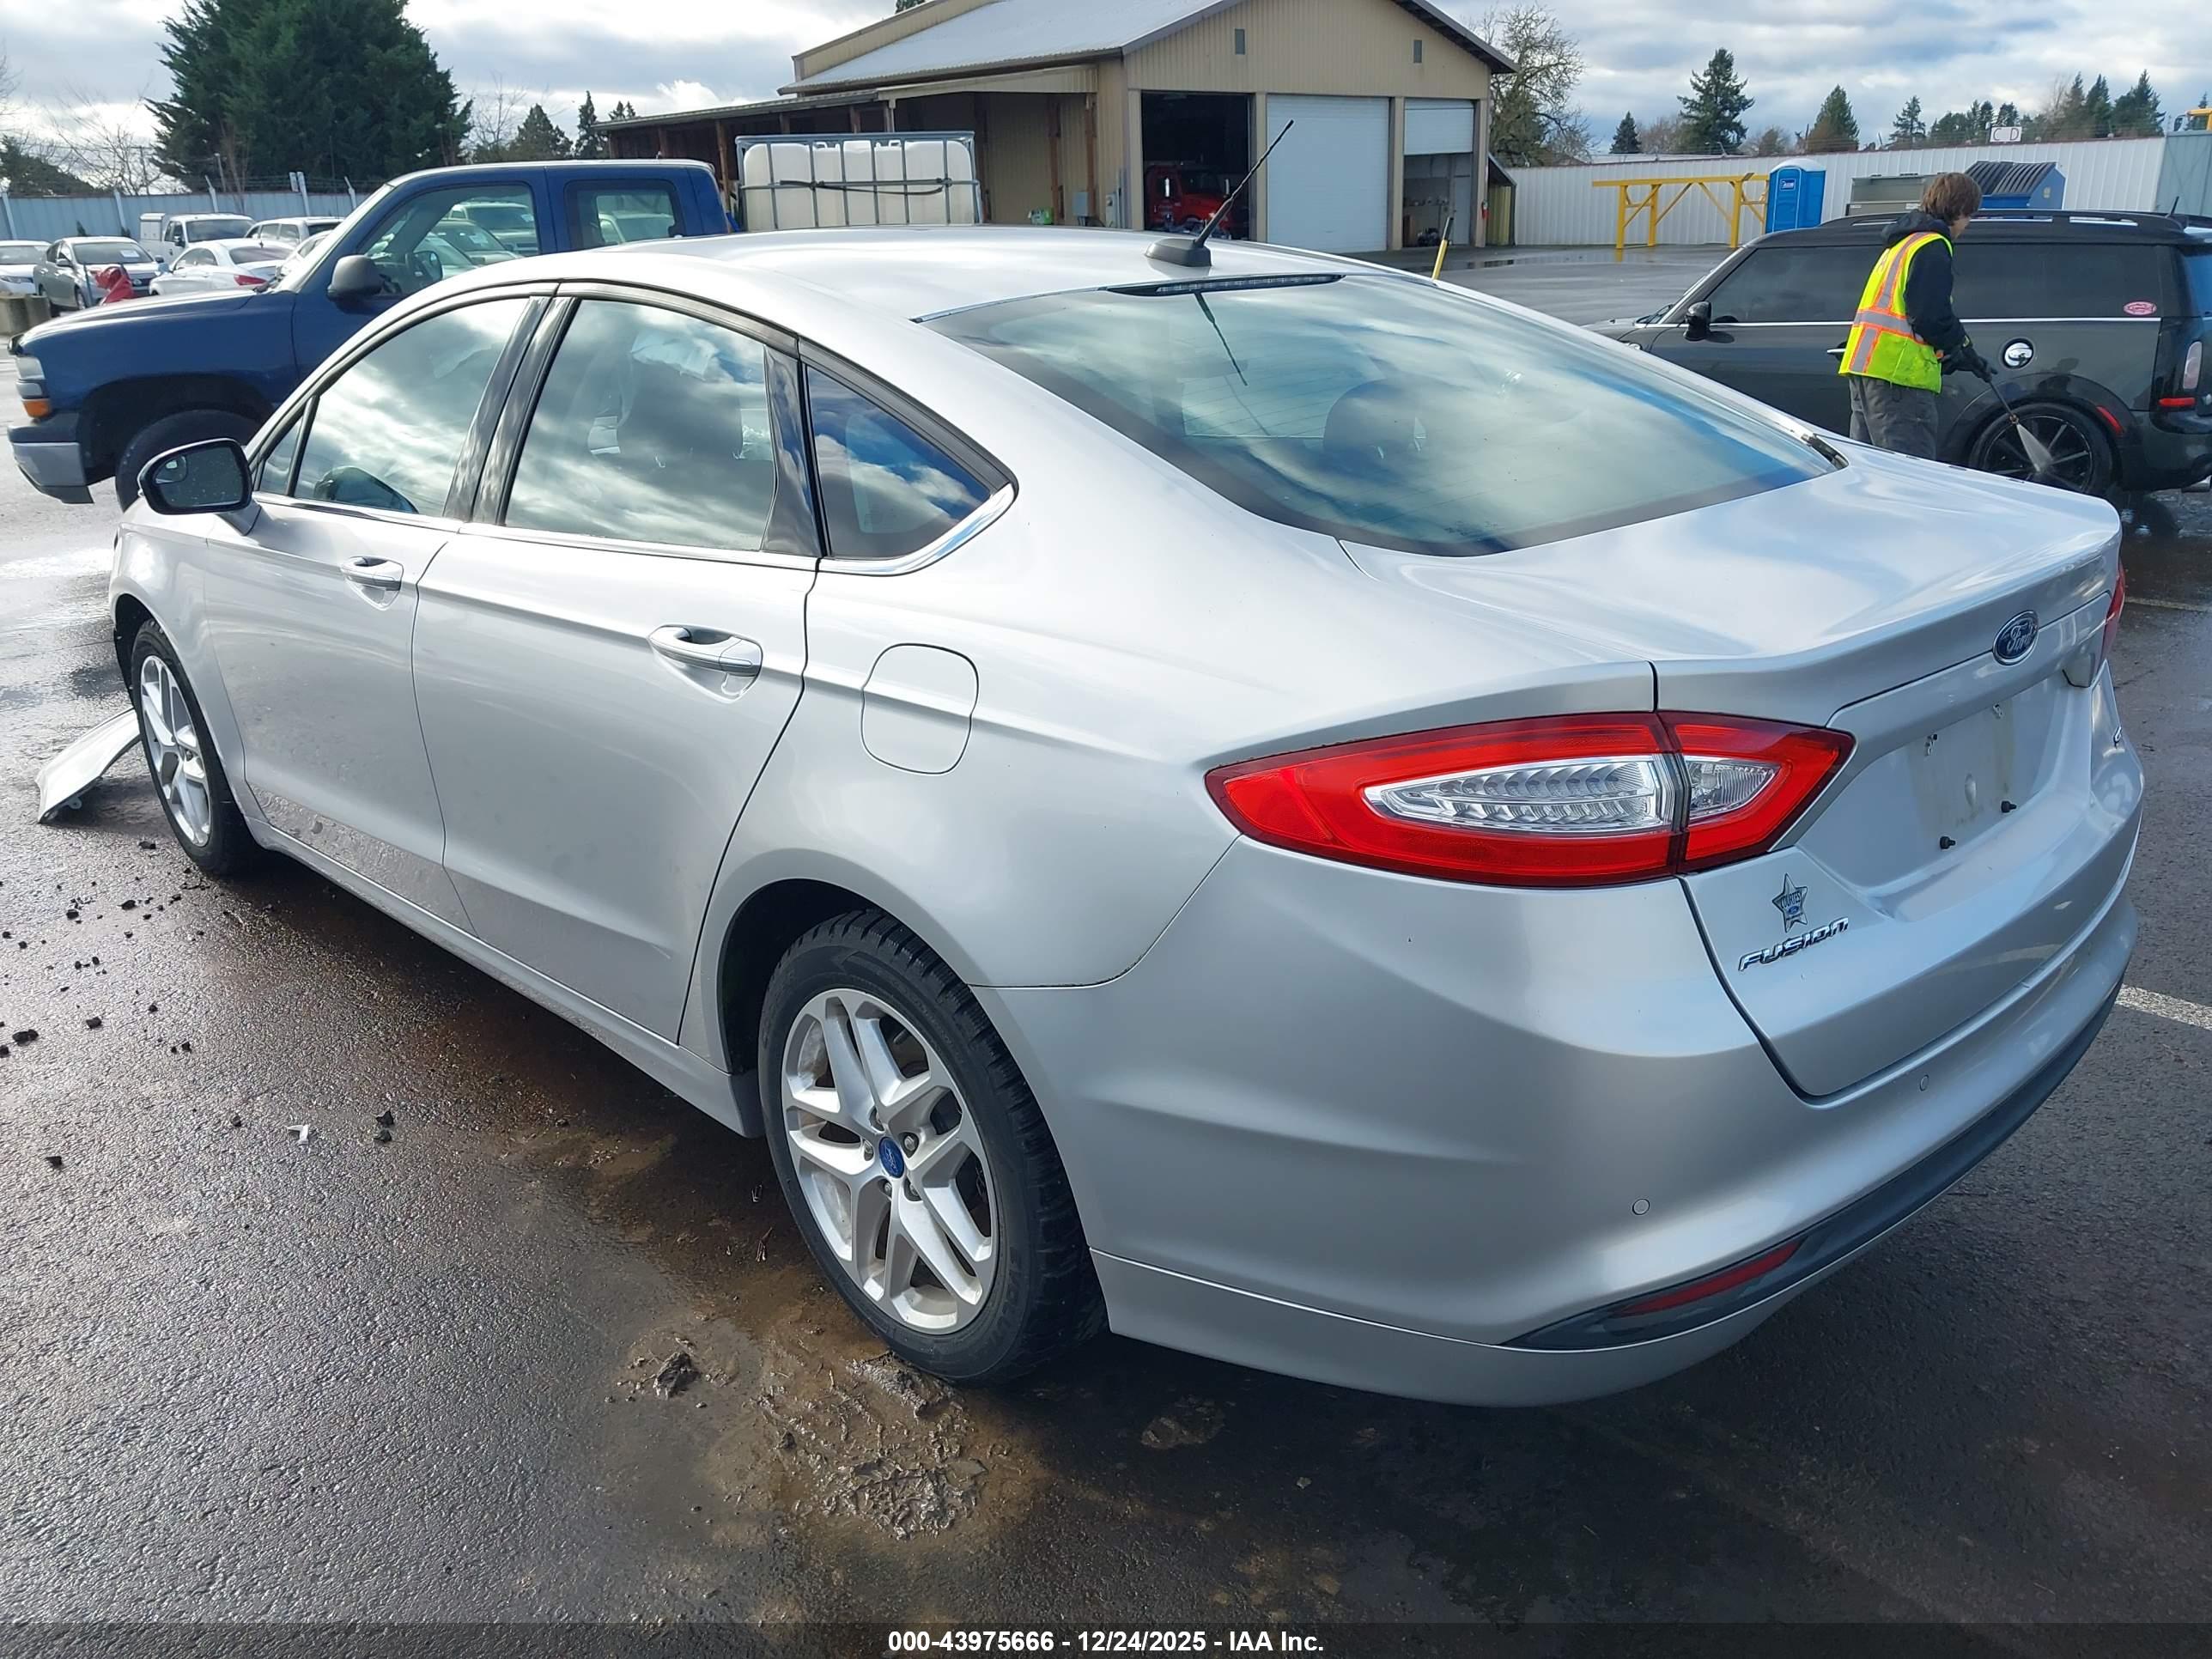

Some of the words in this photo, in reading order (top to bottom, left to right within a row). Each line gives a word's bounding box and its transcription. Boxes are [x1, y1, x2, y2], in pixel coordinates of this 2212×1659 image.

[1993, 128, 2002, 141] C
[2009, 128, 2019, 141] D
[2006, 621, 2036, 652] Ford
